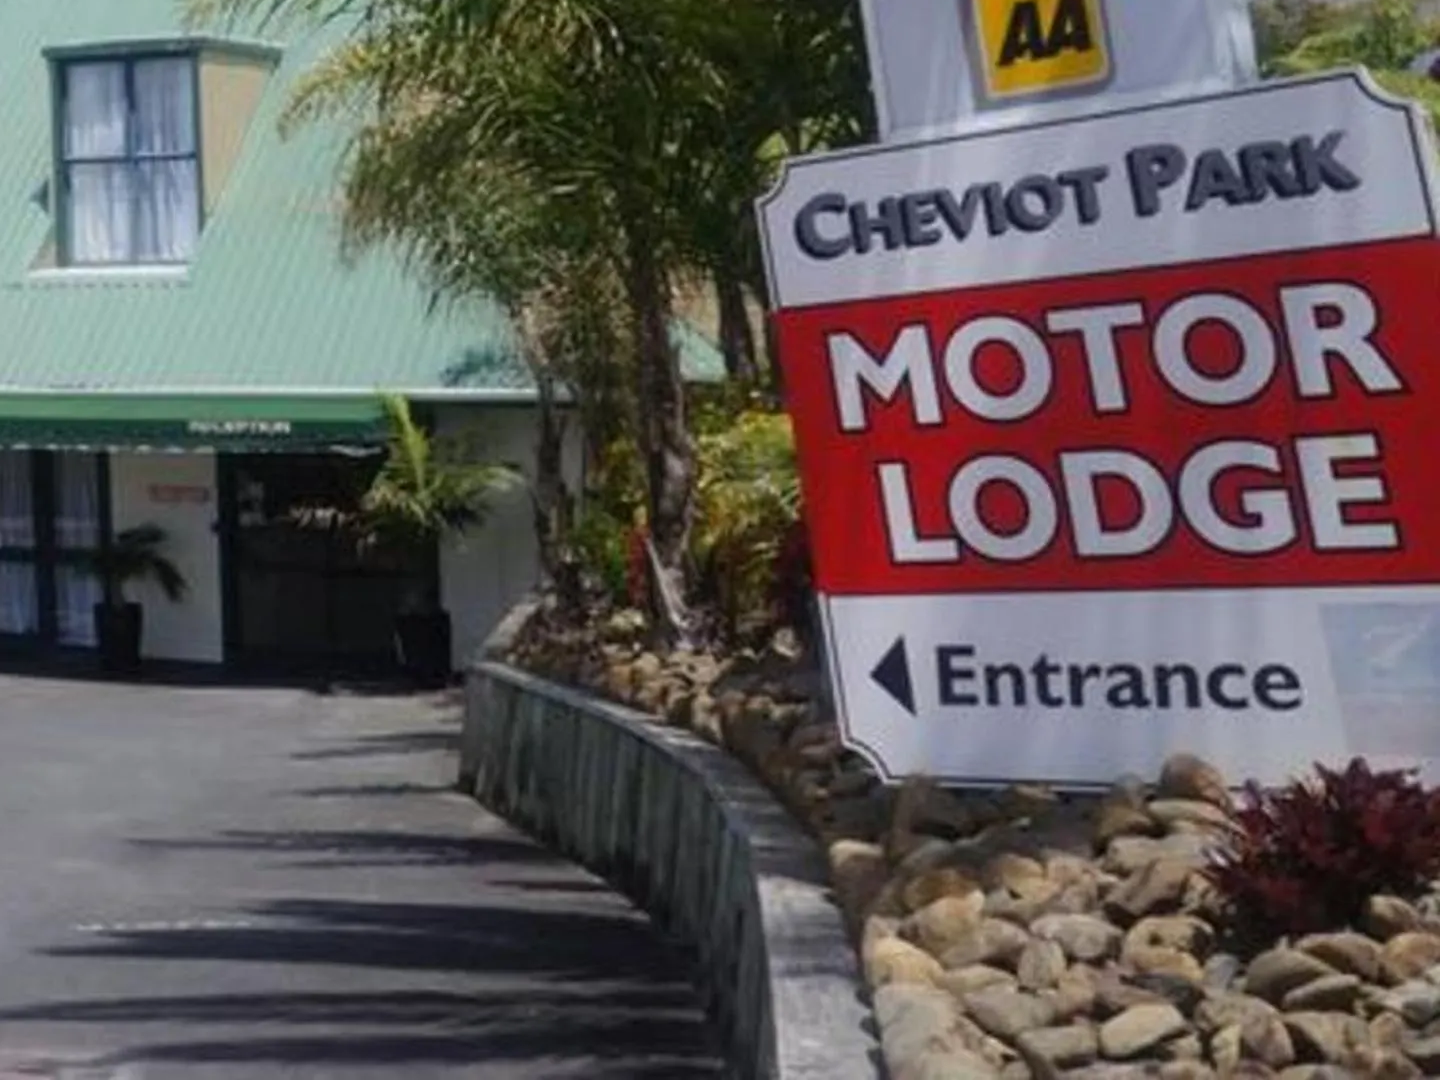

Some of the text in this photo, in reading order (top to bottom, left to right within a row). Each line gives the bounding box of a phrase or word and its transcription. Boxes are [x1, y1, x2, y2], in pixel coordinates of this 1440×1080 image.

[794, 130, 1361, 260] CHEVIOT PARK
[824, 280, 1406, 432] MOTOR
[875, 432, 1402, 565] LODGE
[935, 644, 1303, 711] Entrance
